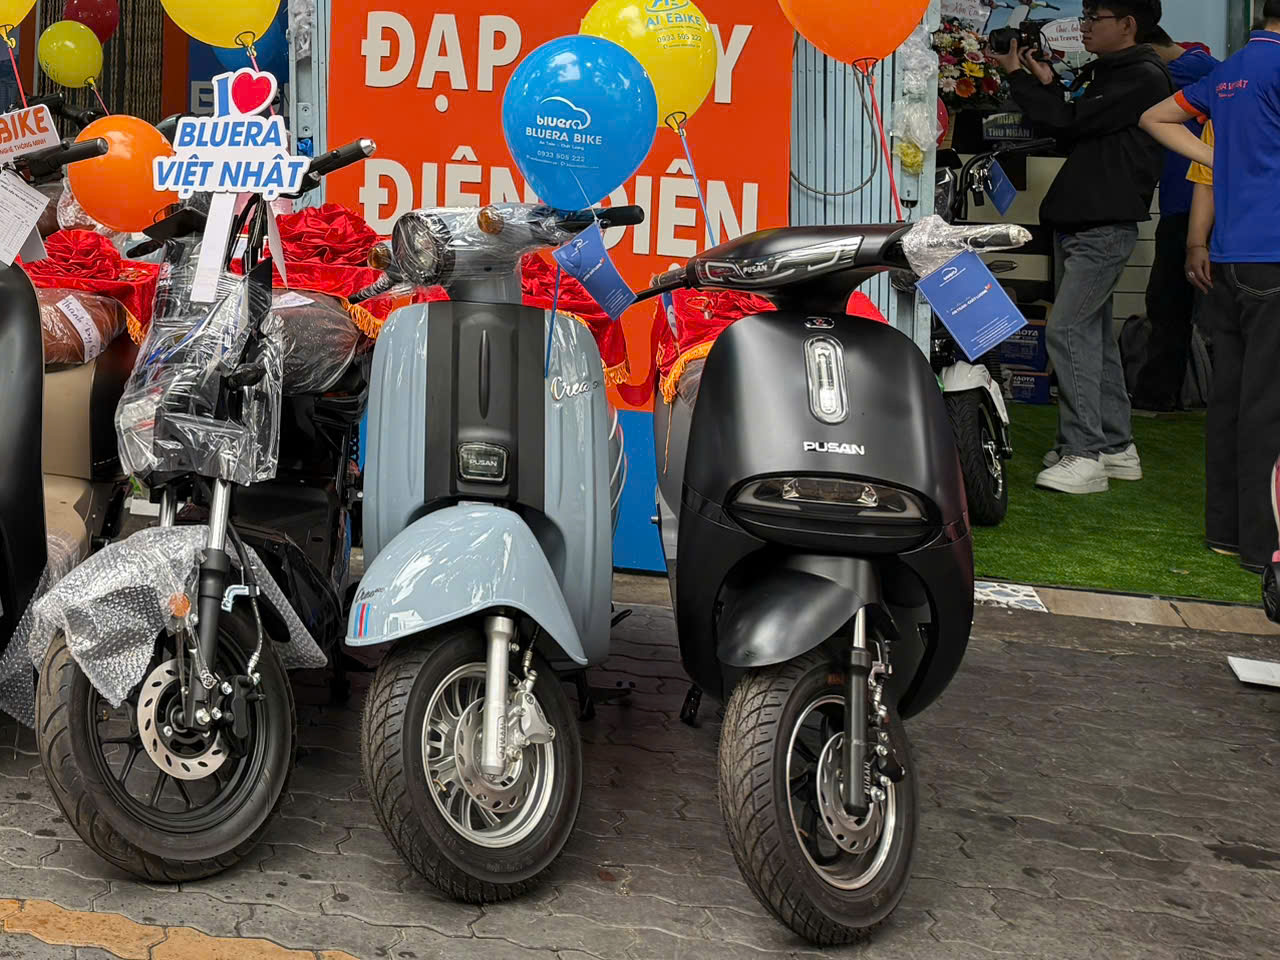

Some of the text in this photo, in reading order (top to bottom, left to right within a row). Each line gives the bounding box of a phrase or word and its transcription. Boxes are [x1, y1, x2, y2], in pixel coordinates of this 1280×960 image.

[361, 11, 521, 113] ĐẠP
[178, 121, 282, 148] BLUERA
[526, 127, 602, 145] BLUERA BIKE
[537, 150, 553, 158] 0933
[158, 156, 303, 199] VIỆT NHẬT
[743, 264, 768, 274] PUSAN
[803, 441, 865, 456] PUSAN
